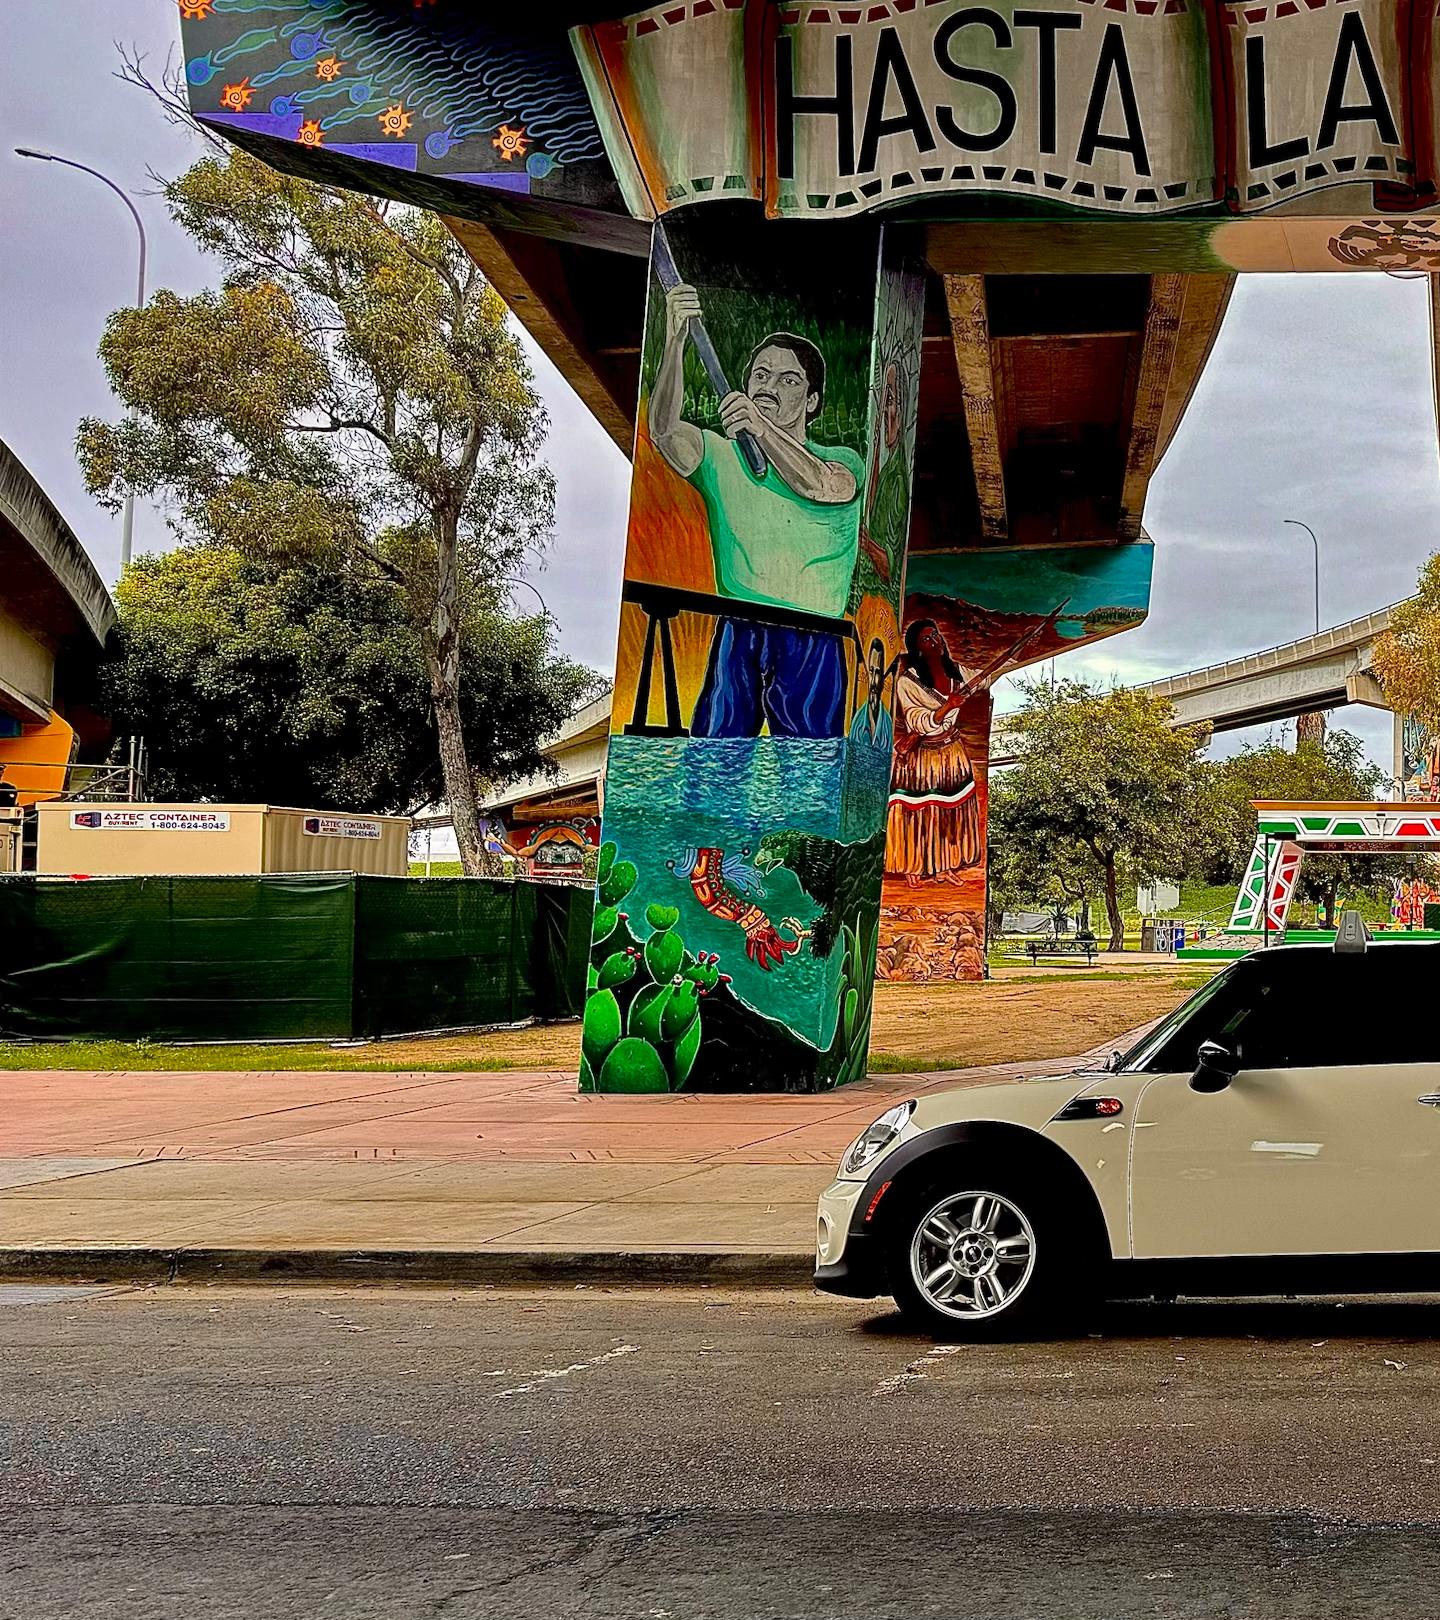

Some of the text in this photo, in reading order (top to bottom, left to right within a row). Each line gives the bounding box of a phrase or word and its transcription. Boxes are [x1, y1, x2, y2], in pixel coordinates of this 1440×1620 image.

[775, 8, 1151, 181] HASTA
[1245, 9, 1401, 170] LA
[104, 813, 217, 822] AZTEC CONTAINER
[151, 822, 226, 830] 1-800-624-8045
[320, 820, 341, 828] AZTEC
